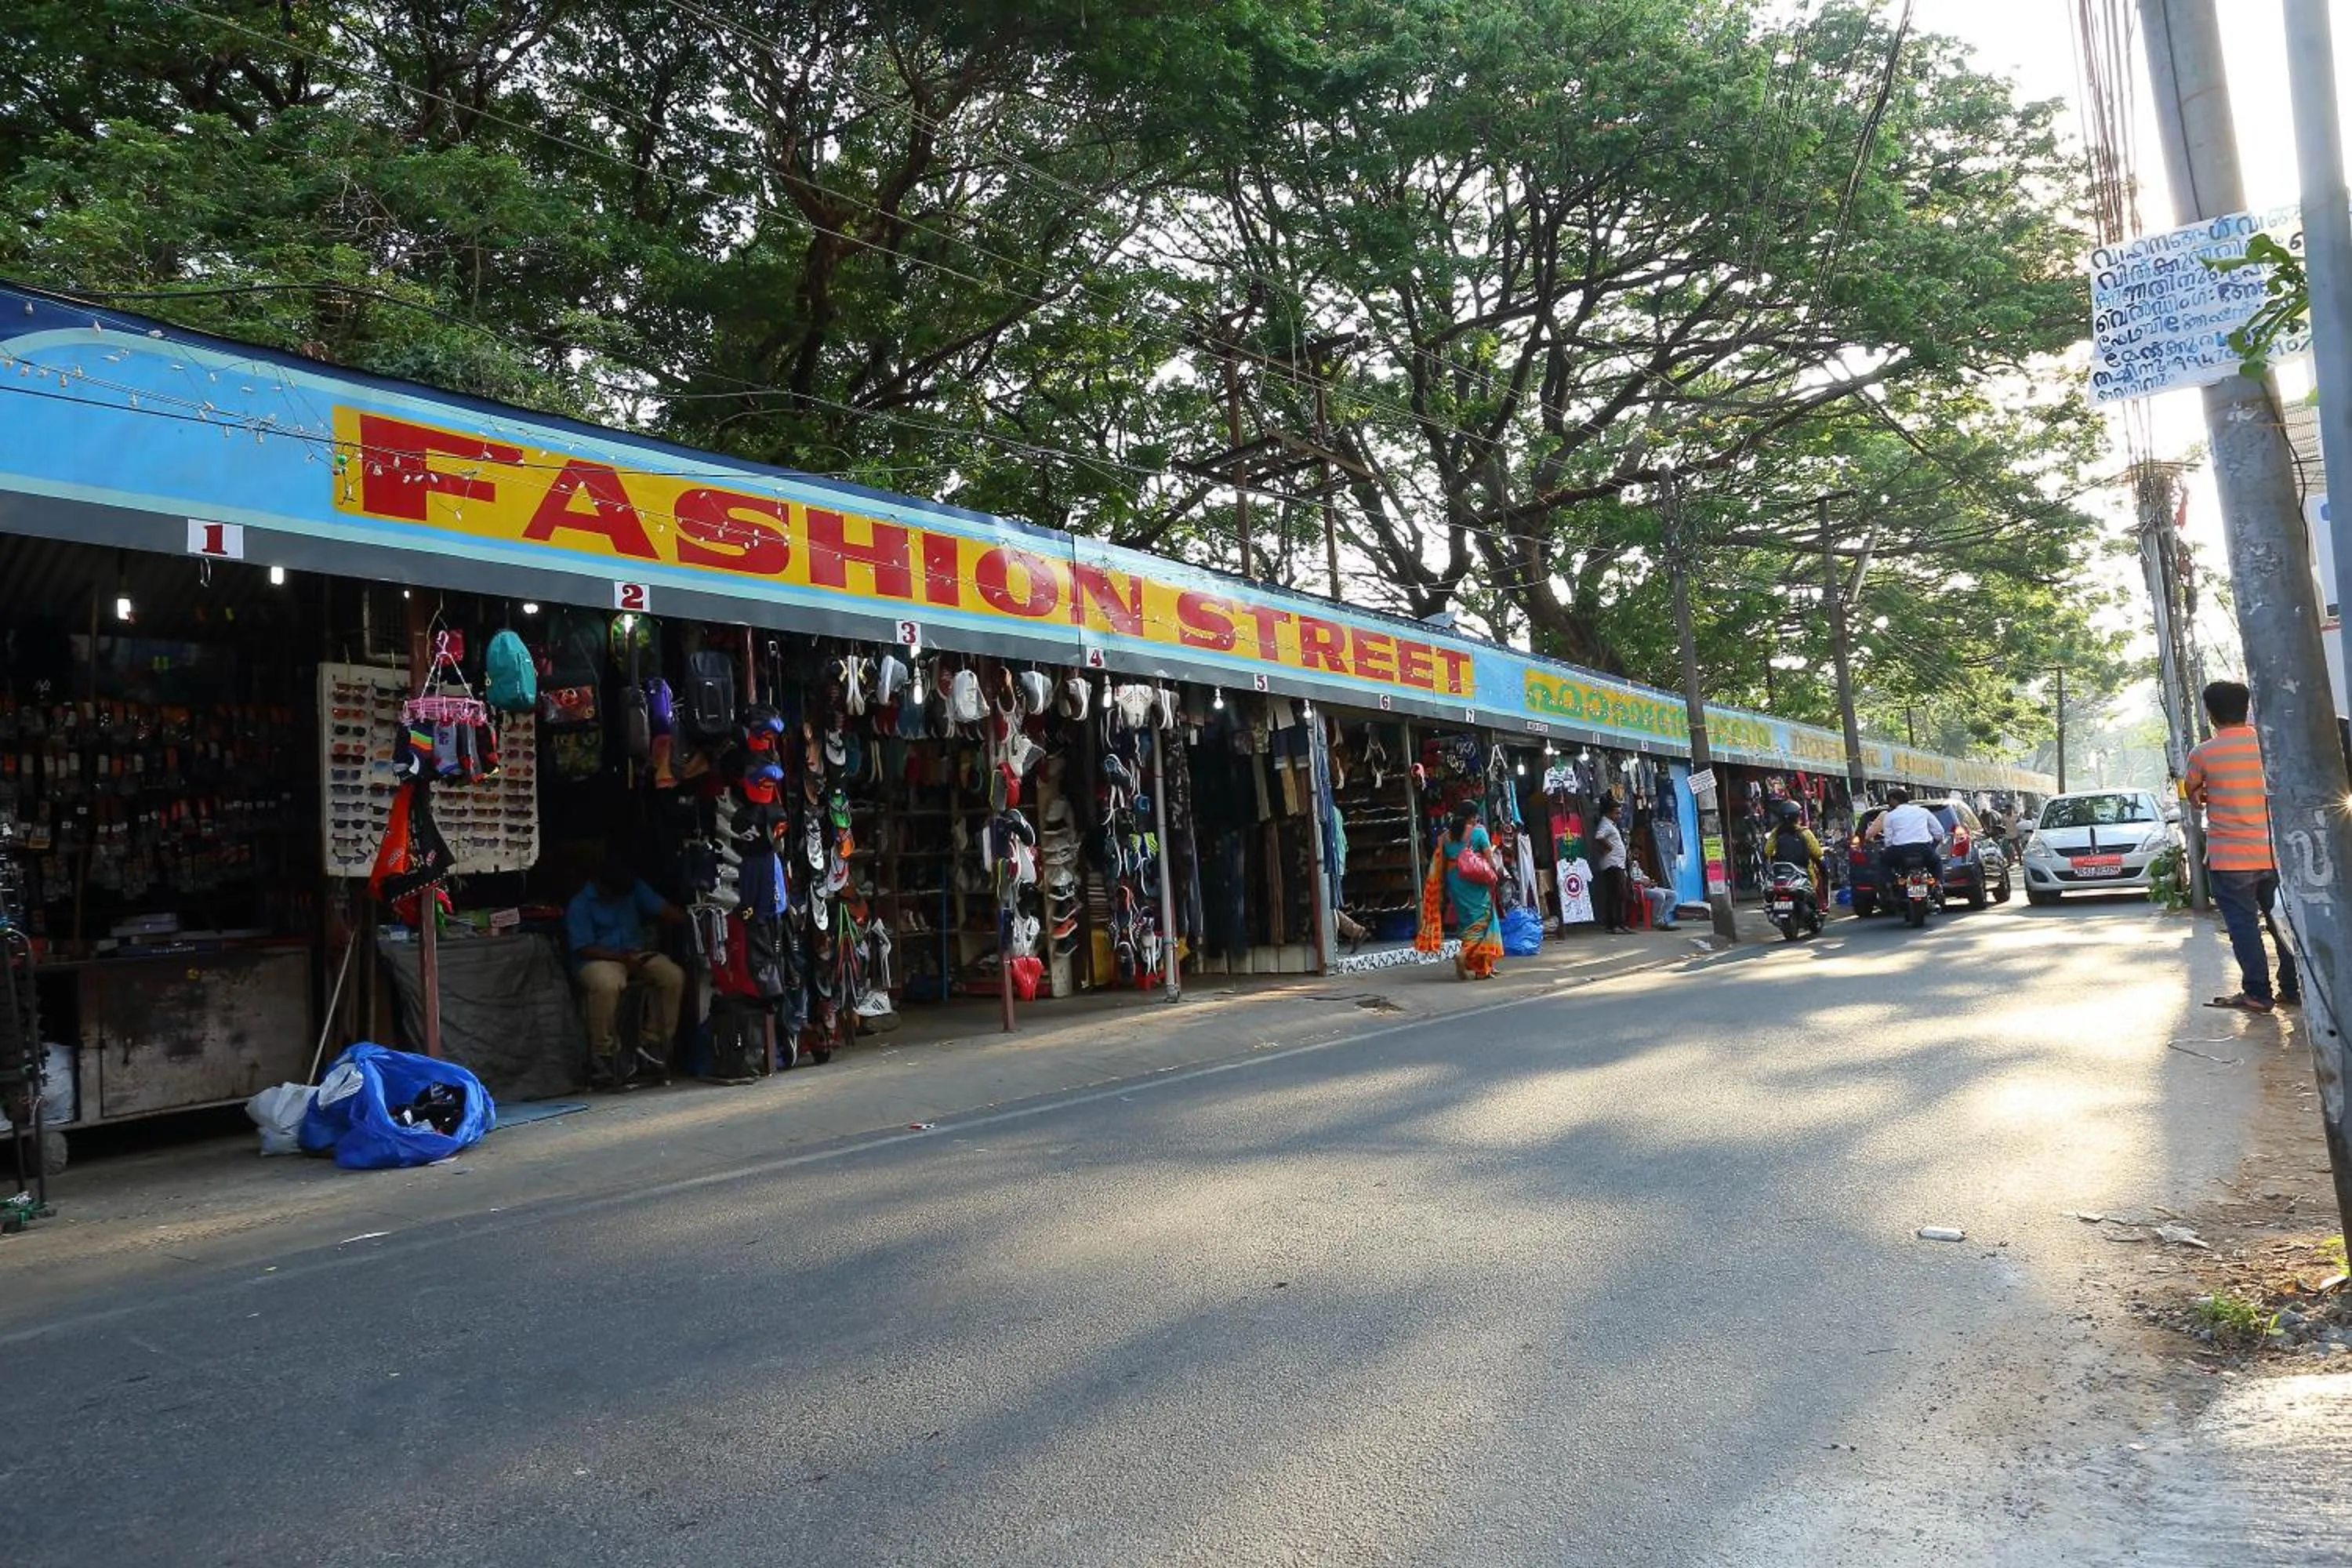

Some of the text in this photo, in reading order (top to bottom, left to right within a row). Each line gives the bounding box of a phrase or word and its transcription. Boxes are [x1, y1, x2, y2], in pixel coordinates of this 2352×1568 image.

[201, 522, 228, 555] 1
[360, 414, 1471, 695] FASHION STREET
[622, 584, 644, 609] 2
[902, 622, 917, 644] 3
[1089, 649, 1103, 667] 4
[1256, 675, 1266, 690] 5
